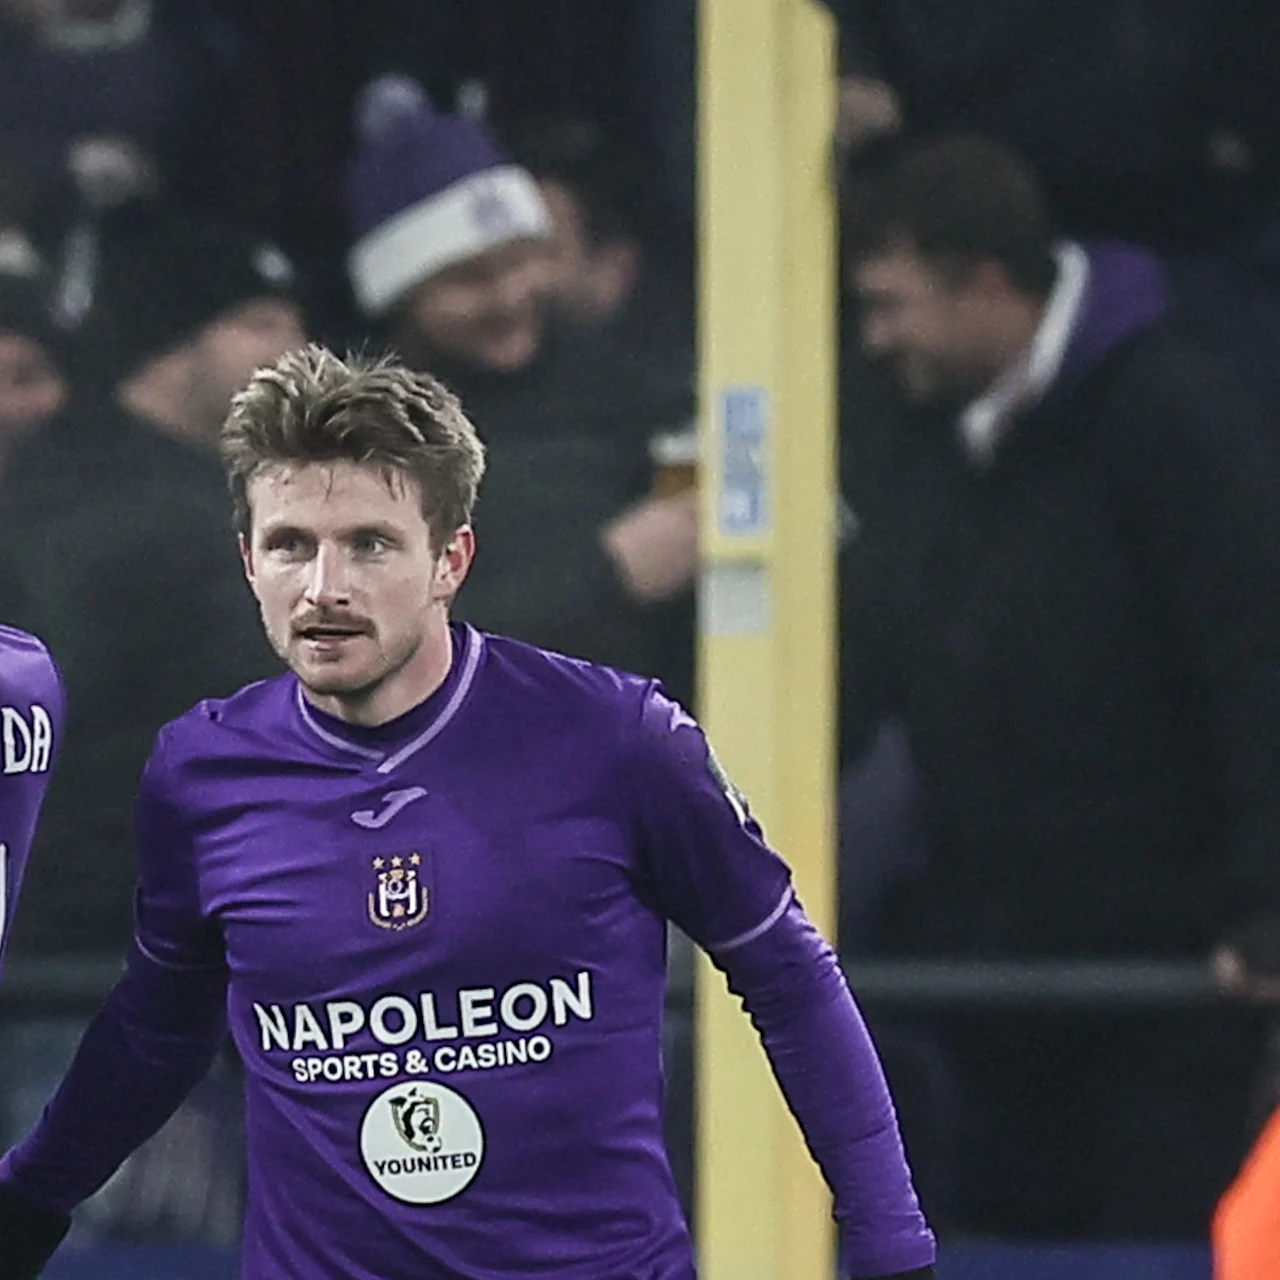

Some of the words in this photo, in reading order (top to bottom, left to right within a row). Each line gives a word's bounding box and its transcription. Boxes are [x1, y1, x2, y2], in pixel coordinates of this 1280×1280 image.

[253, 971, 592, 1052] NAPOLEON
[293, 1052, 399, 1082] SPORTS
[404, 1051, 428, 1074] &
[434, 1035, 551, 1073] CASINO
[373, 1152, 477, 1177] YOUNITED
